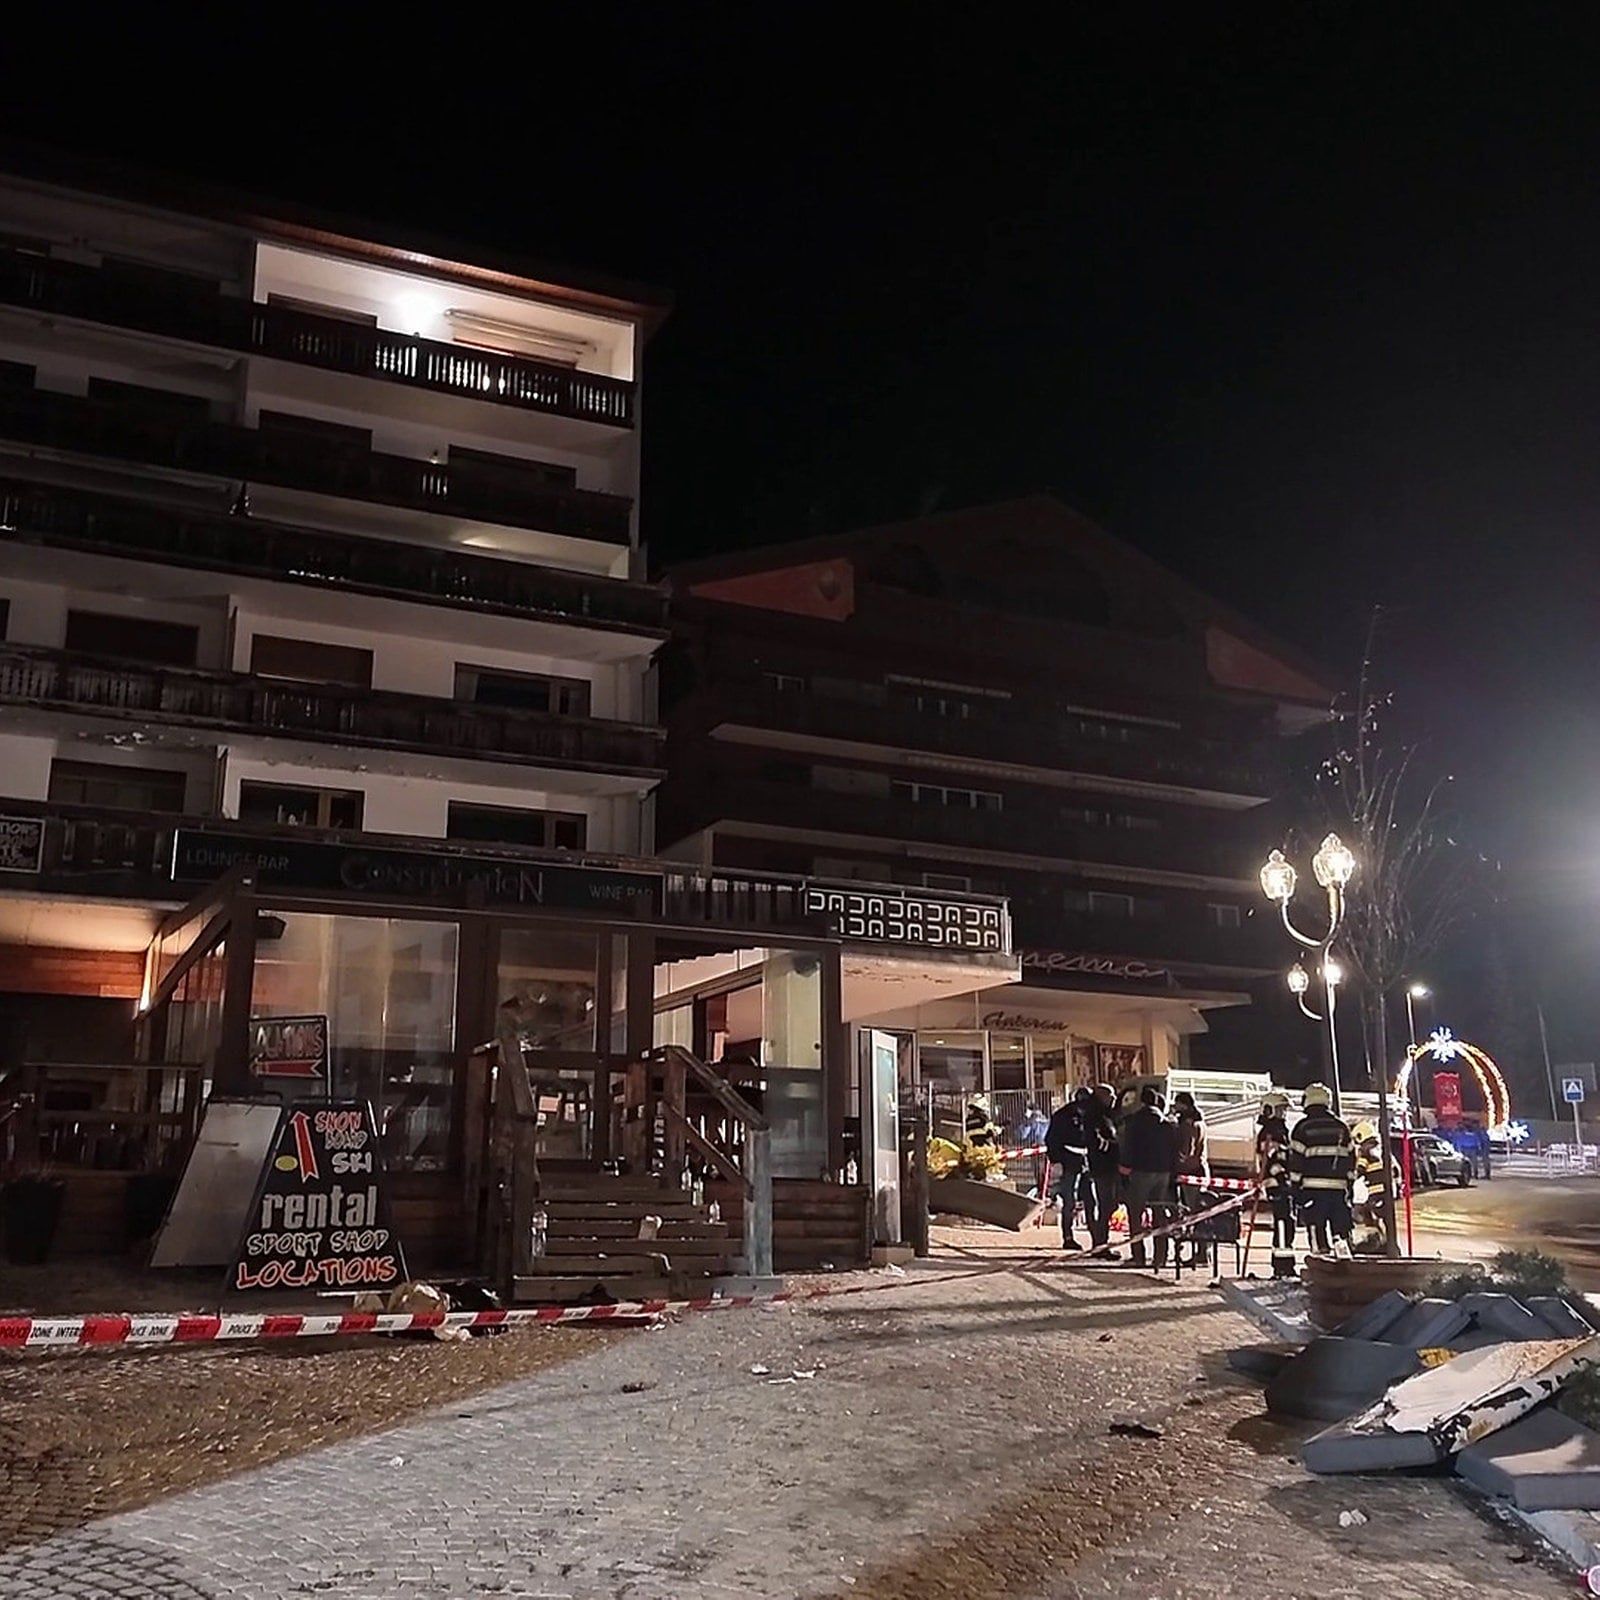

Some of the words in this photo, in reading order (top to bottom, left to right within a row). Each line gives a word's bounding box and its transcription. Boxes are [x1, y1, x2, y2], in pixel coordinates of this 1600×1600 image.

[257, 853, 290, 871] BAR
[314, 1111, 362, 1132] SNOW
[332, 1152, 372, 1174] SKI
[261, 1185, 377, 1229] rental
[247, 1232, 322, 1257] SPORT
[330, 1230, 389, 1253] SHOP
[236, 1255, 397, 1289] LOCATIONS
[31, 1326, 52, 1339] ZONE
